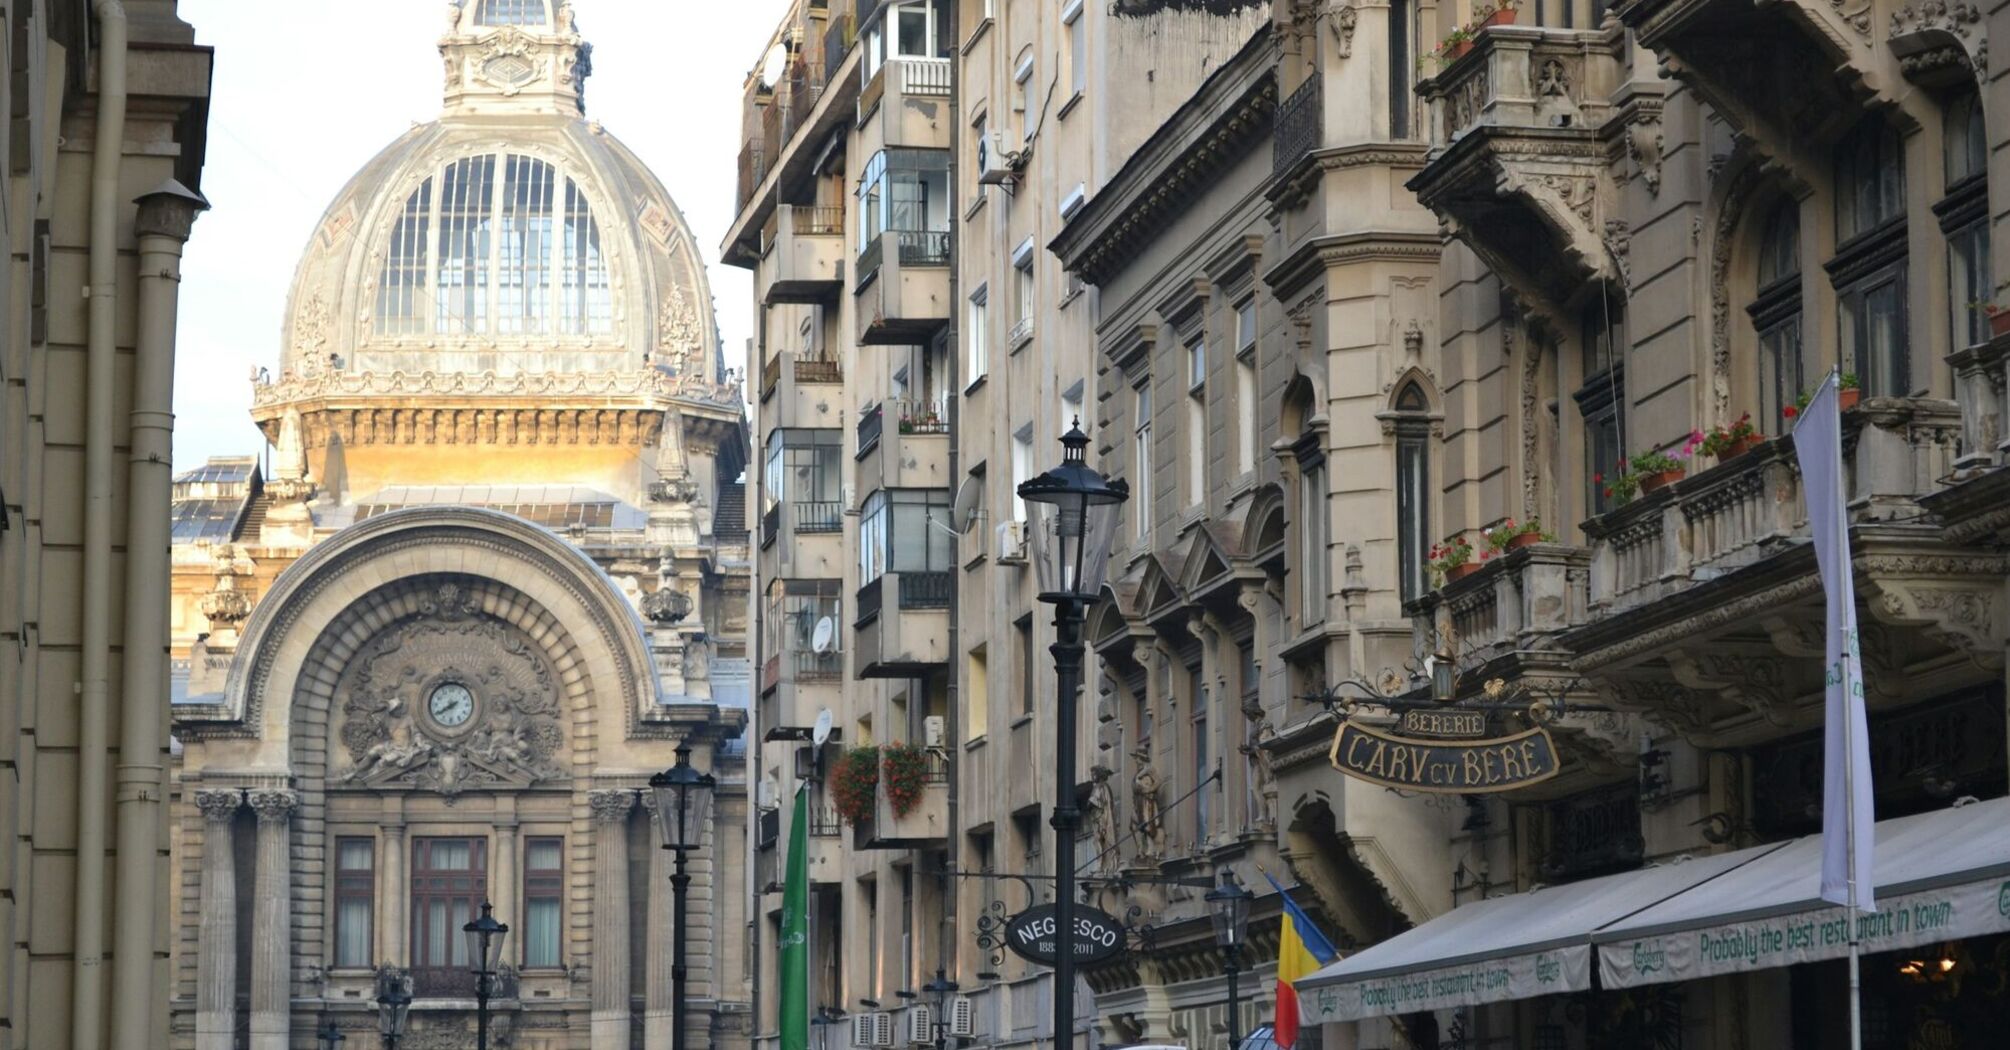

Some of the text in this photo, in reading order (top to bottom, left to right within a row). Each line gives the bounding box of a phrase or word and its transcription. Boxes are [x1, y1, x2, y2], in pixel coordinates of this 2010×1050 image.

[1407, 713, 1483, 733] BERERIE
[1462, 739, 1541, 785] BERE
[1017, 917, 1116, 947] NEGESCO
[1073, 943, 1094, 955] 2011
[1700, 928, 1758, 965] Probably
[1761, 922, 1783, 954] the
[1787, 919, 1815, 950] best
[1897, 902, 1909, 932] in
[1914, 901, 1952, 930] town
[1360, 983, 1397, 1010] Probably
[1398, 980, 1411, 1001] the
[1413, 978, 1429, 998] best
[1432, 971, 1475, 997] restaurant
[1487, 968, 1509, 990] town
